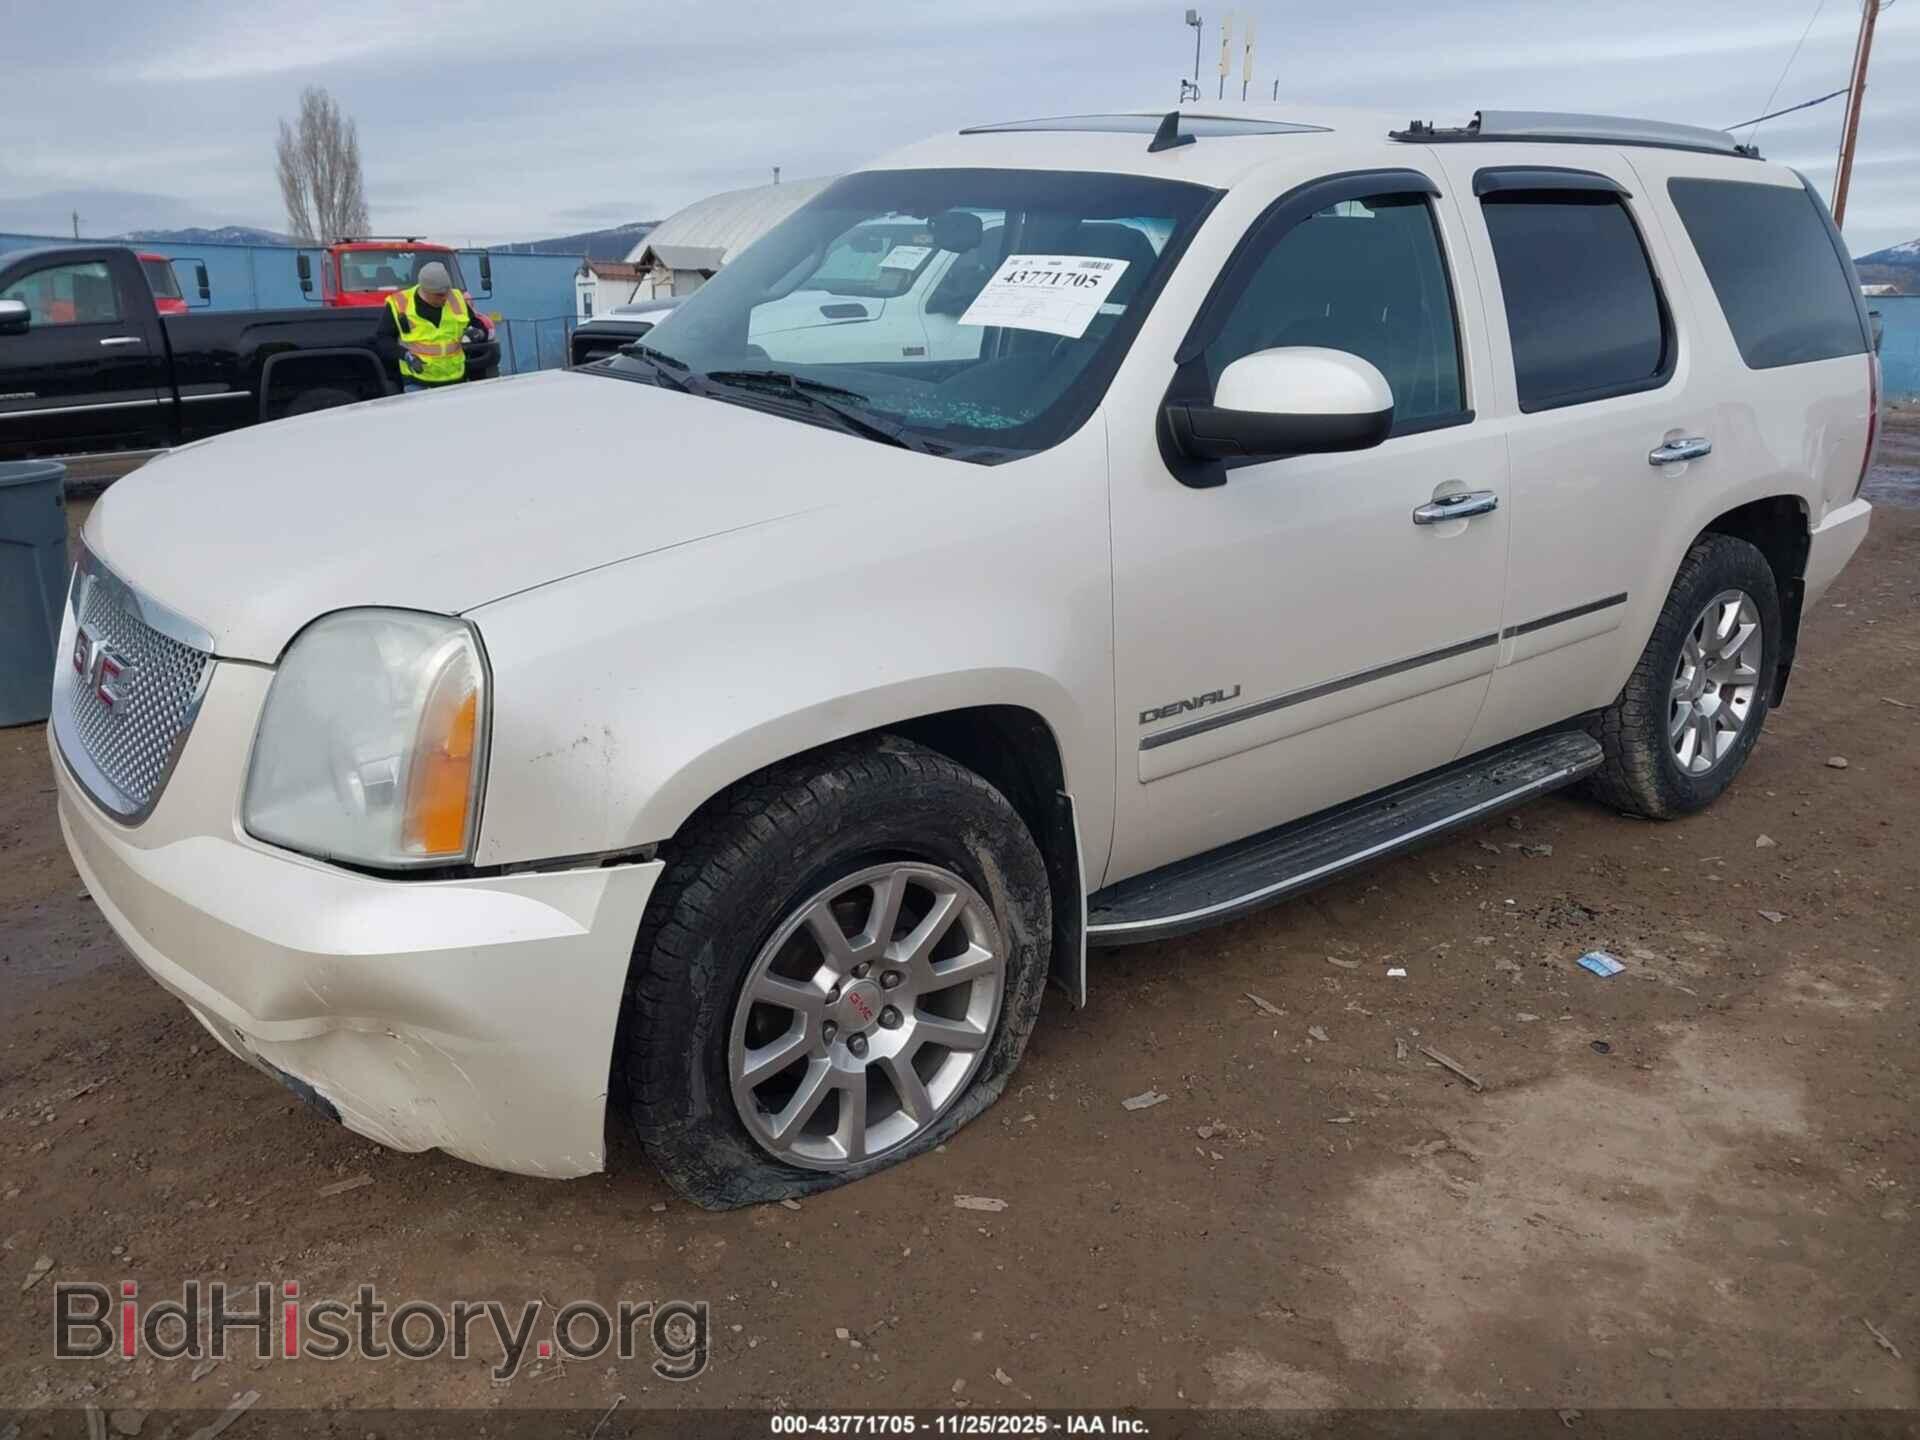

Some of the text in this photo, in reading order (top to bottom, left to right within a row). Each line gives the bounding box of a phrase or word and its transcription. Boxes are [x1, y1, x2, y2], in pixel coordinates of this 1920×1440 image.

[1003, 270, 1103, 289] 43771705
[1139, 684, 1241, 725] DENALI
[848, 992, 874, 1021] GMC
